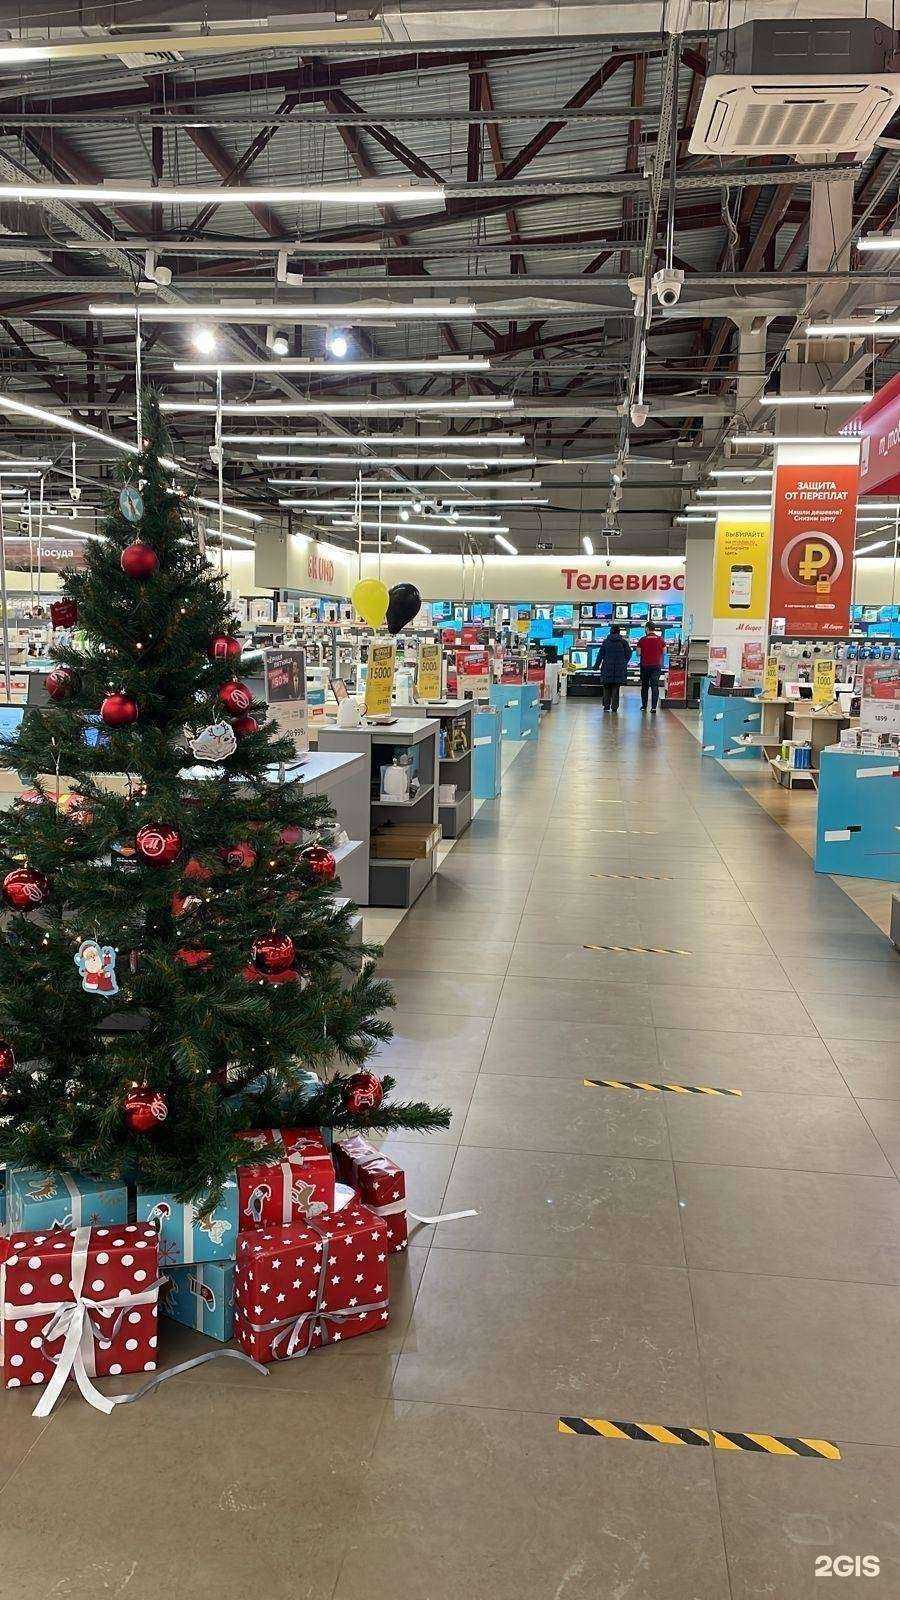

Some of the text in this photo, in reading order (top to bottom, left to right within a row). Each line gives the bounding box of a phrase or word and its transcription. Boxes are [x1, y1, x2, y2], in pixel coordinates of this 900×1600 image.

[797, 482, 836, 490] ЗАЩИТА
[785, 492, 848, 500] ОТ ПЕРЕПЛАТ
[37, 548, 73, 559] Посуда
